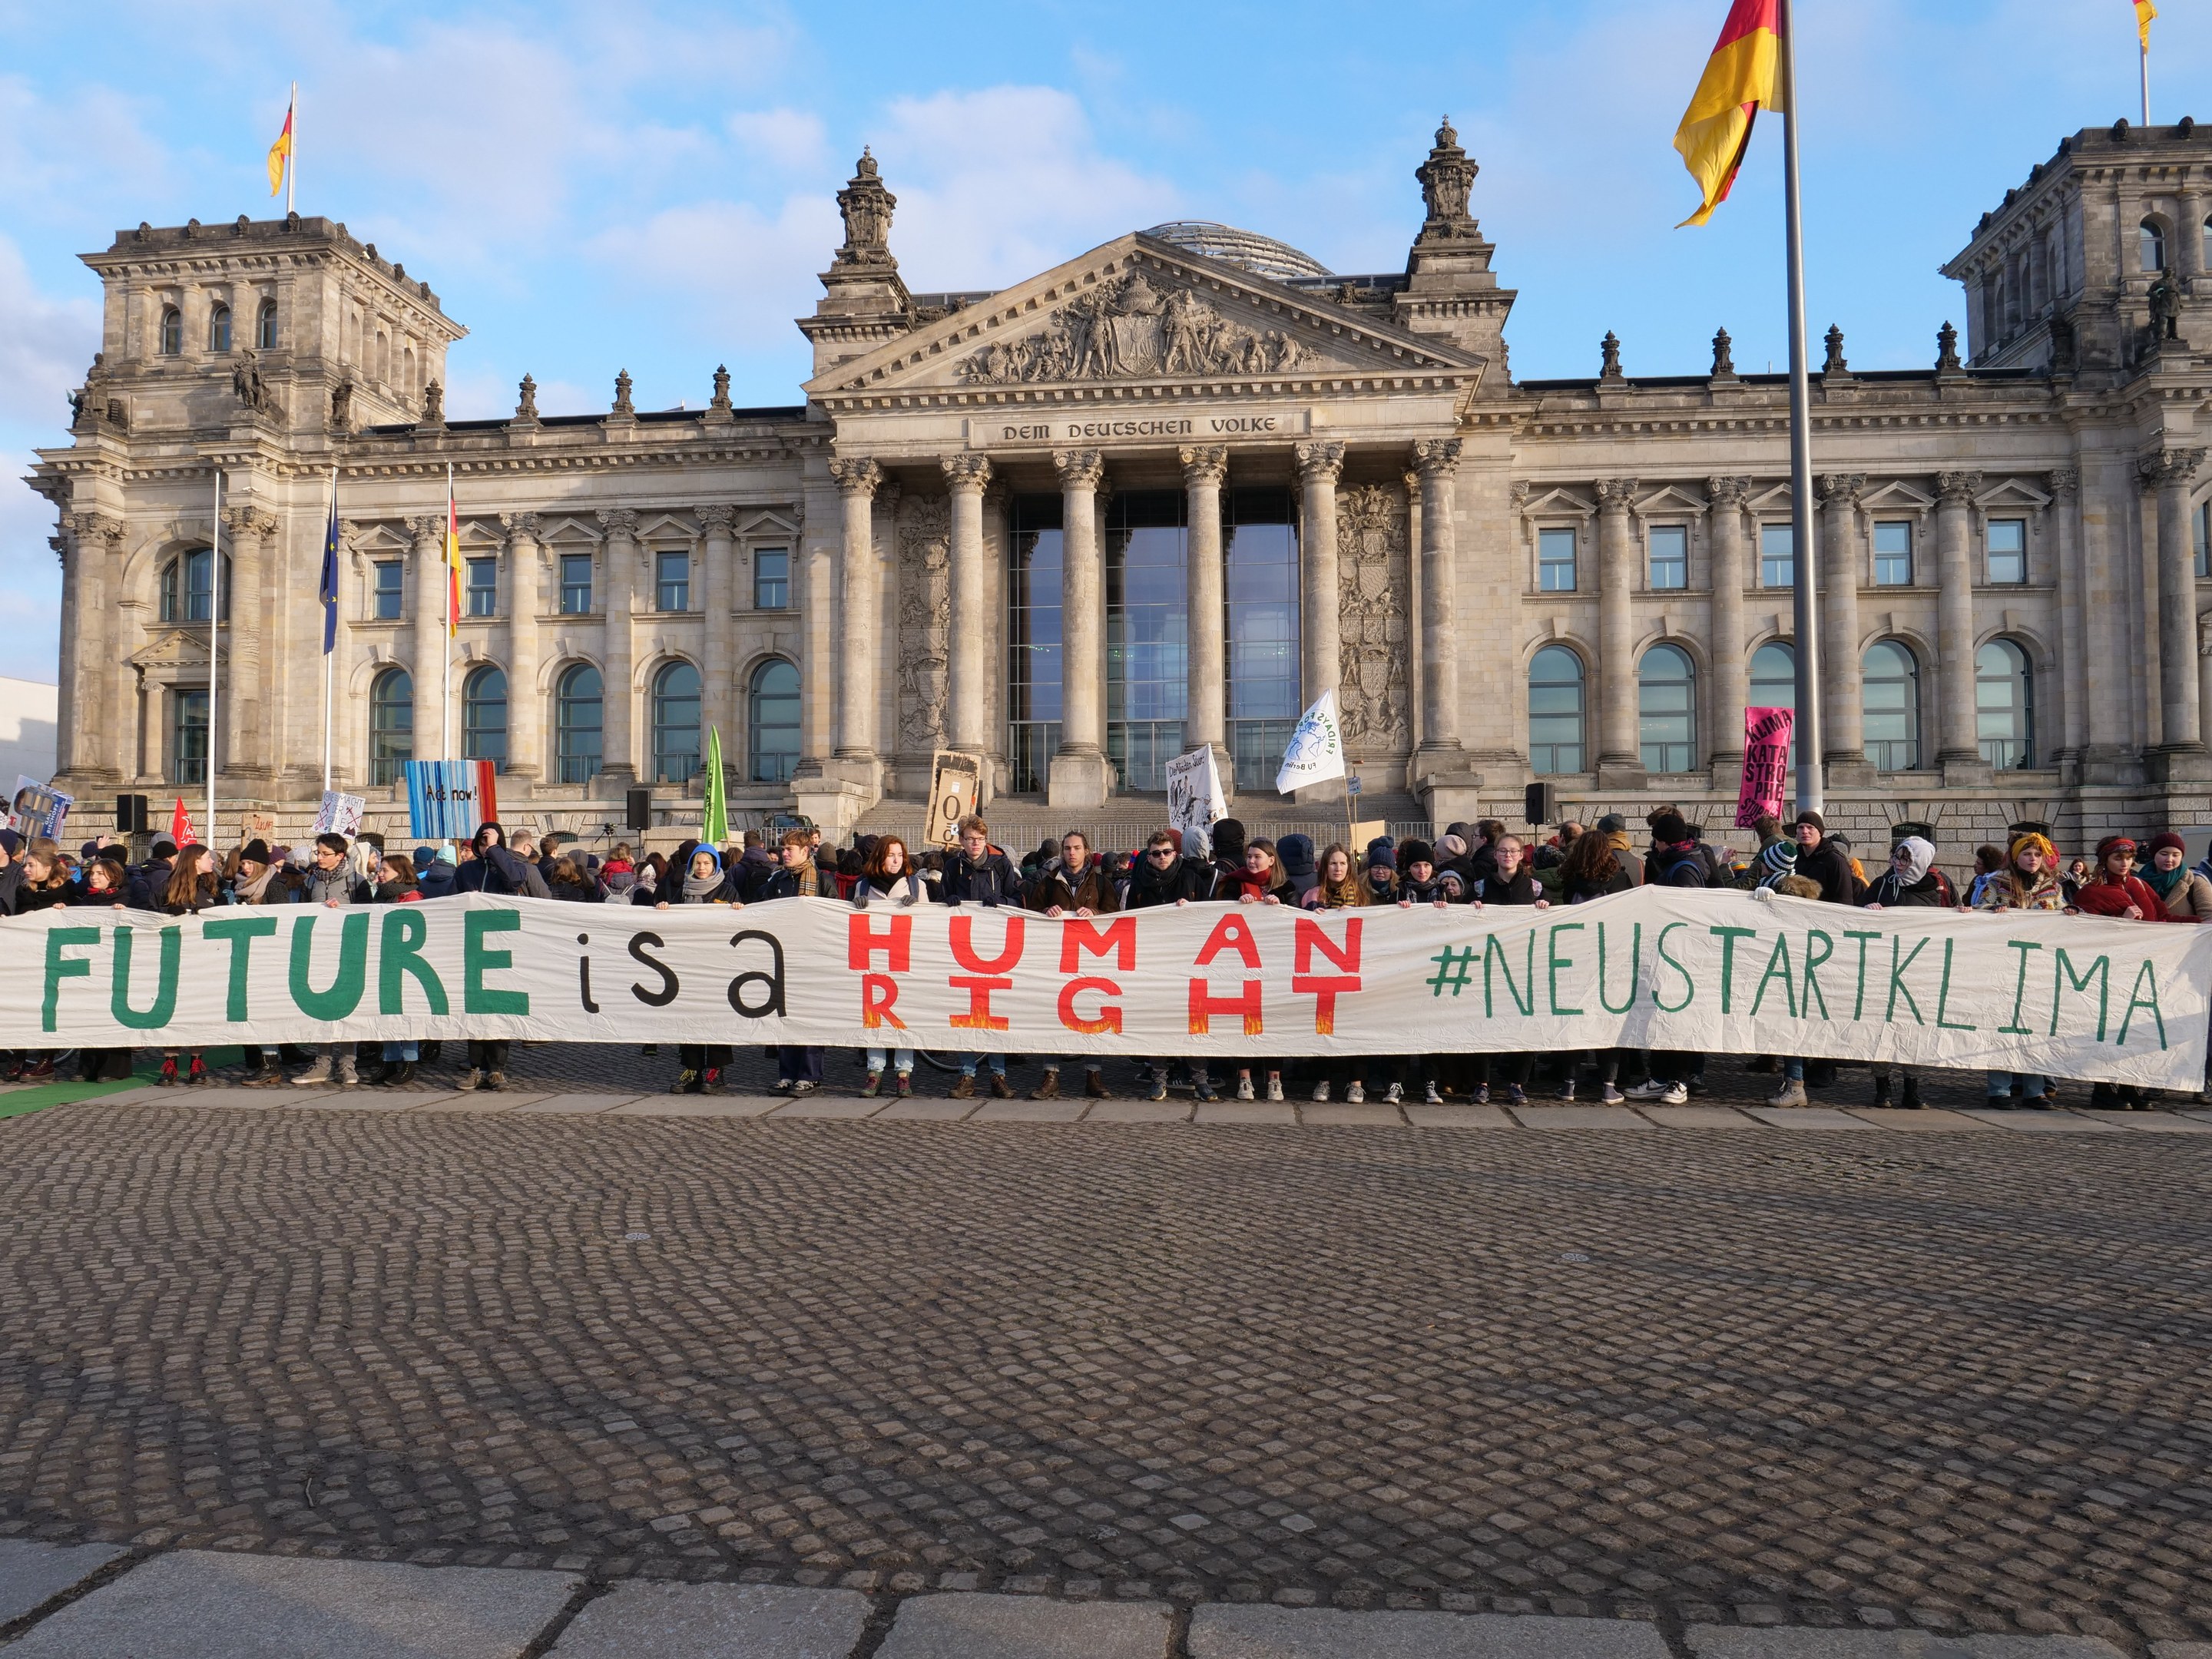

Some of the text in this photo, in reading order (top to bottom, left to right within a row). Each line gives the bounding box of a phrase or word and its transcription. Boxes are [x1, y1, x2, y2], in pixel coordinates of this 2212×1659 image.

[1003, 418, 1276, 440] DEM DEUTSCHEN VOLKE
[1746, 710, 1792, 743] KLIMA
[1747, 744, 1787, 764] KATA
[1745, 763, 1786, 783] STRO
[426, 785, 478, 801] Act now!
[1754, 782, 1783, 802] PHE
[46, 803, 59, 834] BISCHOFF
[1740, 798, 1779, 819] STOP
[848, 913, 1363, 976] HUMAN
[42, 909, 788, 1032] FUTURE is a
[862, 973, 1363, 1035] RIGHT
